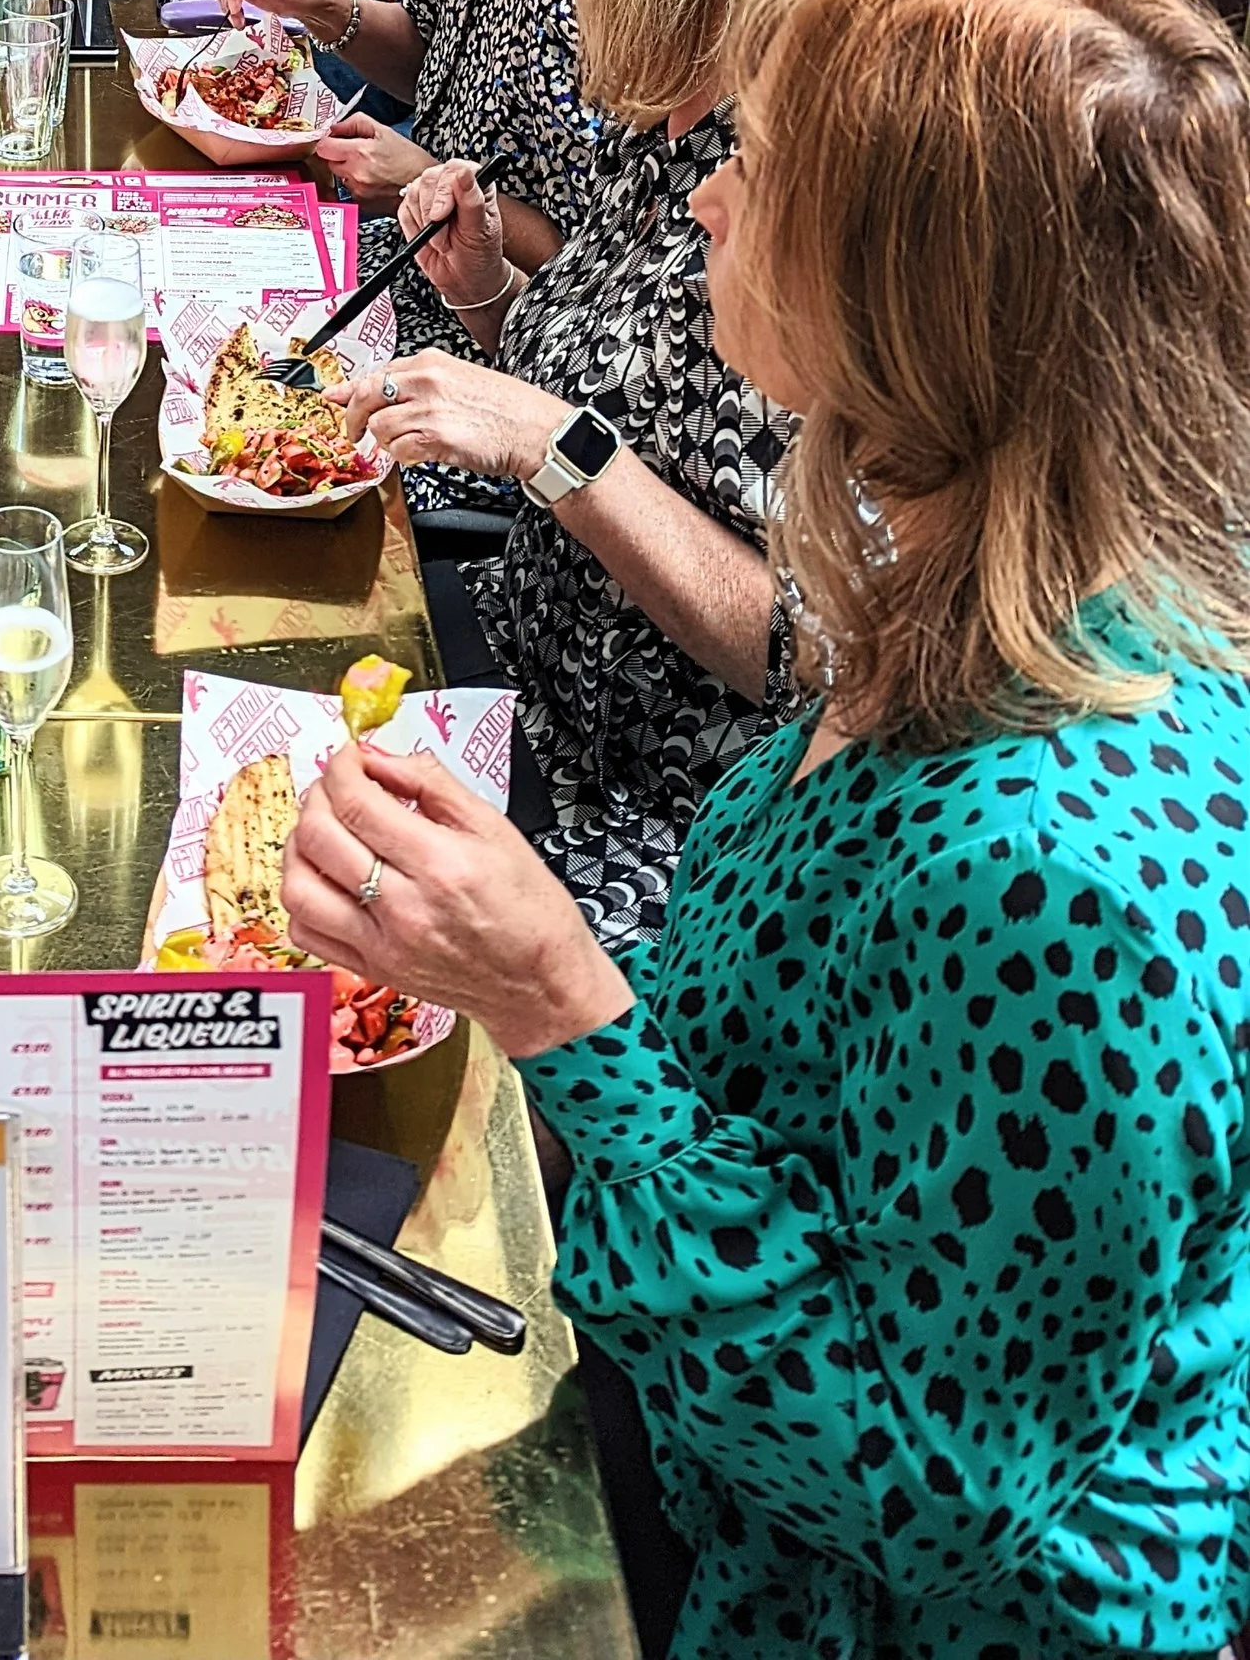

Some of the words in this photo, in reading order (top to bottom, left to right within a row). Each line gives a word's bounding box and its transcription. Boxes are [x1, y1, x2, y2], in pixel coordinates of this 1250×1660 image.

[92, 993, 223, 1020] SPIRITS
[224, 991, 253, 1017] &
[109, 1020, 278, 1051] LIQUEURS
[99, 1367, 187, 1381] MIXERS
